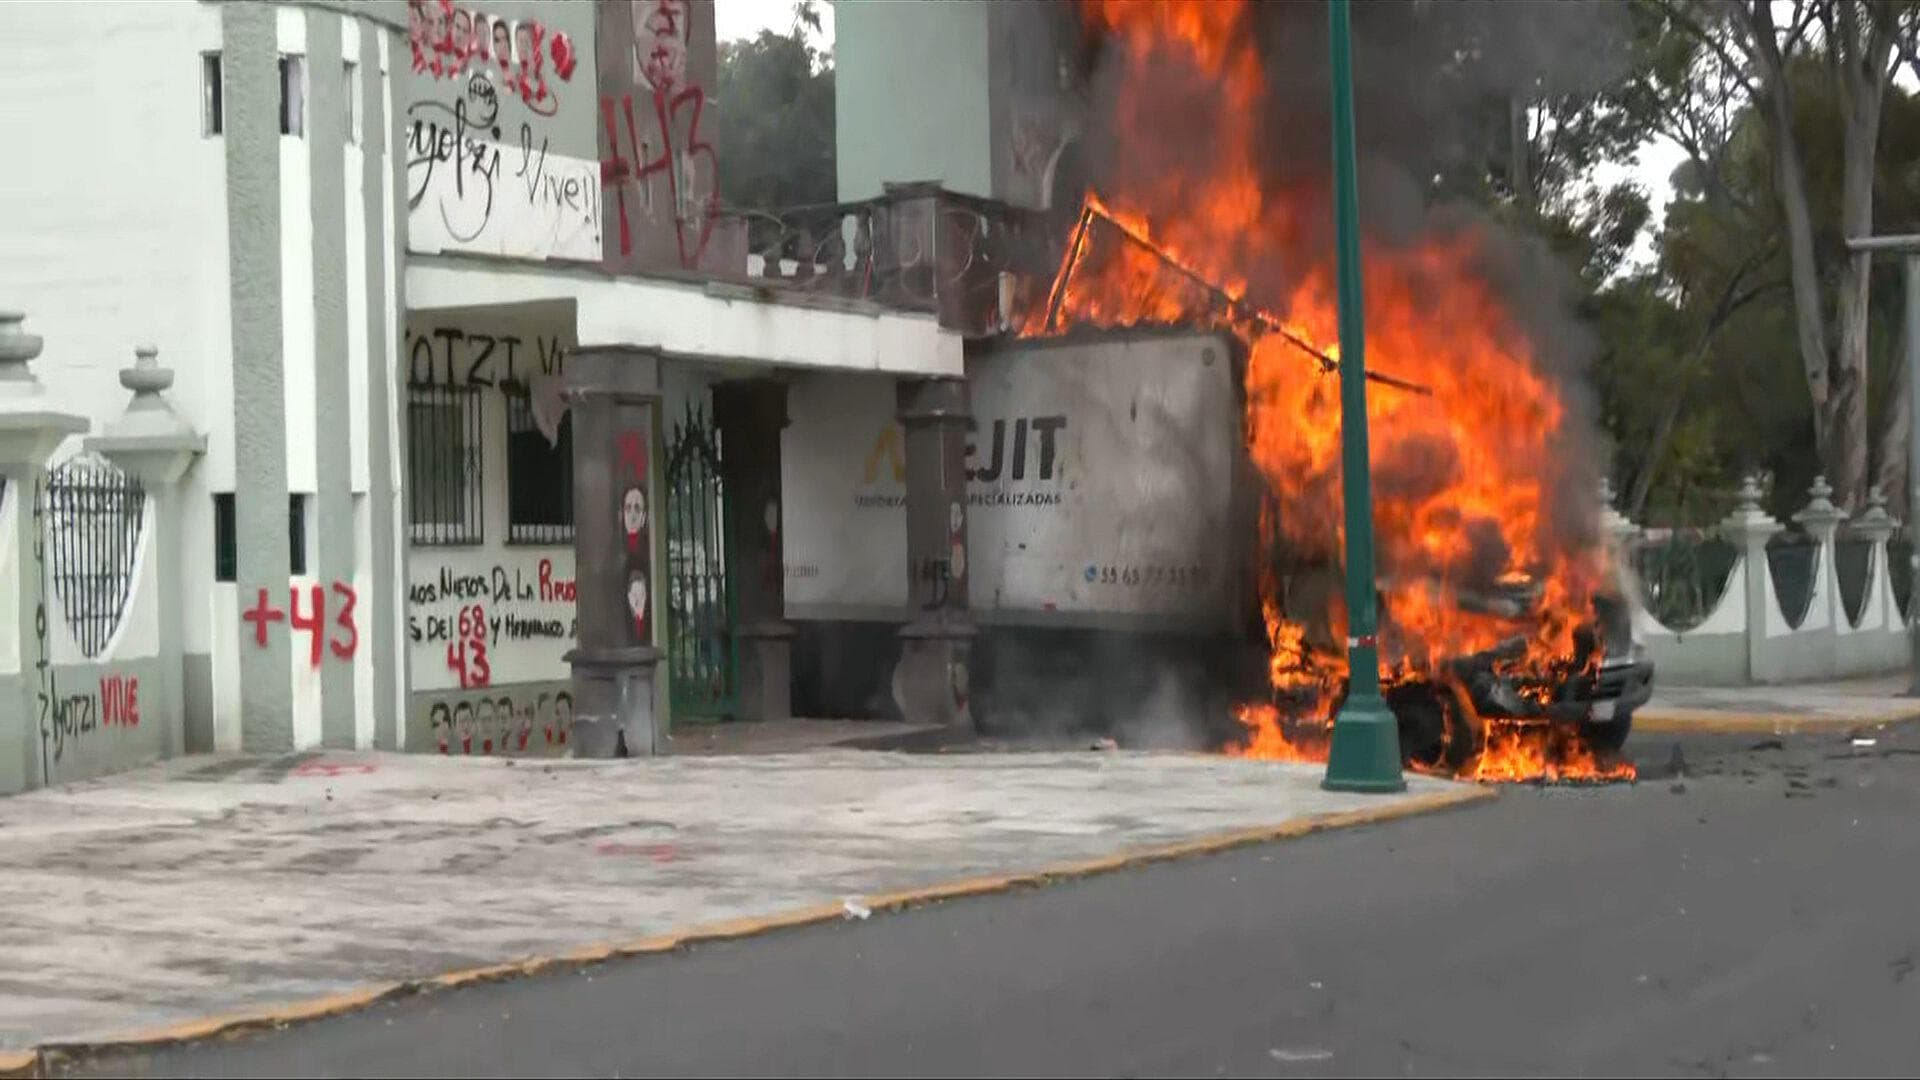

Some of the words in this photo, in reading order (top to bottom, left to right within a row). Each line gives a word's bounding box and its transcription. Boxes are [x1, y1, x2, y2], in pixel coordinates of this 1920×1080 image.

[405, 325, 521, 388] OTZI
[242, 578, 360, 671] +43
[458, 605, 487, 640] 68
[447, 639, 490, 690] 43
[99, 674, 140, 729] VIVE
